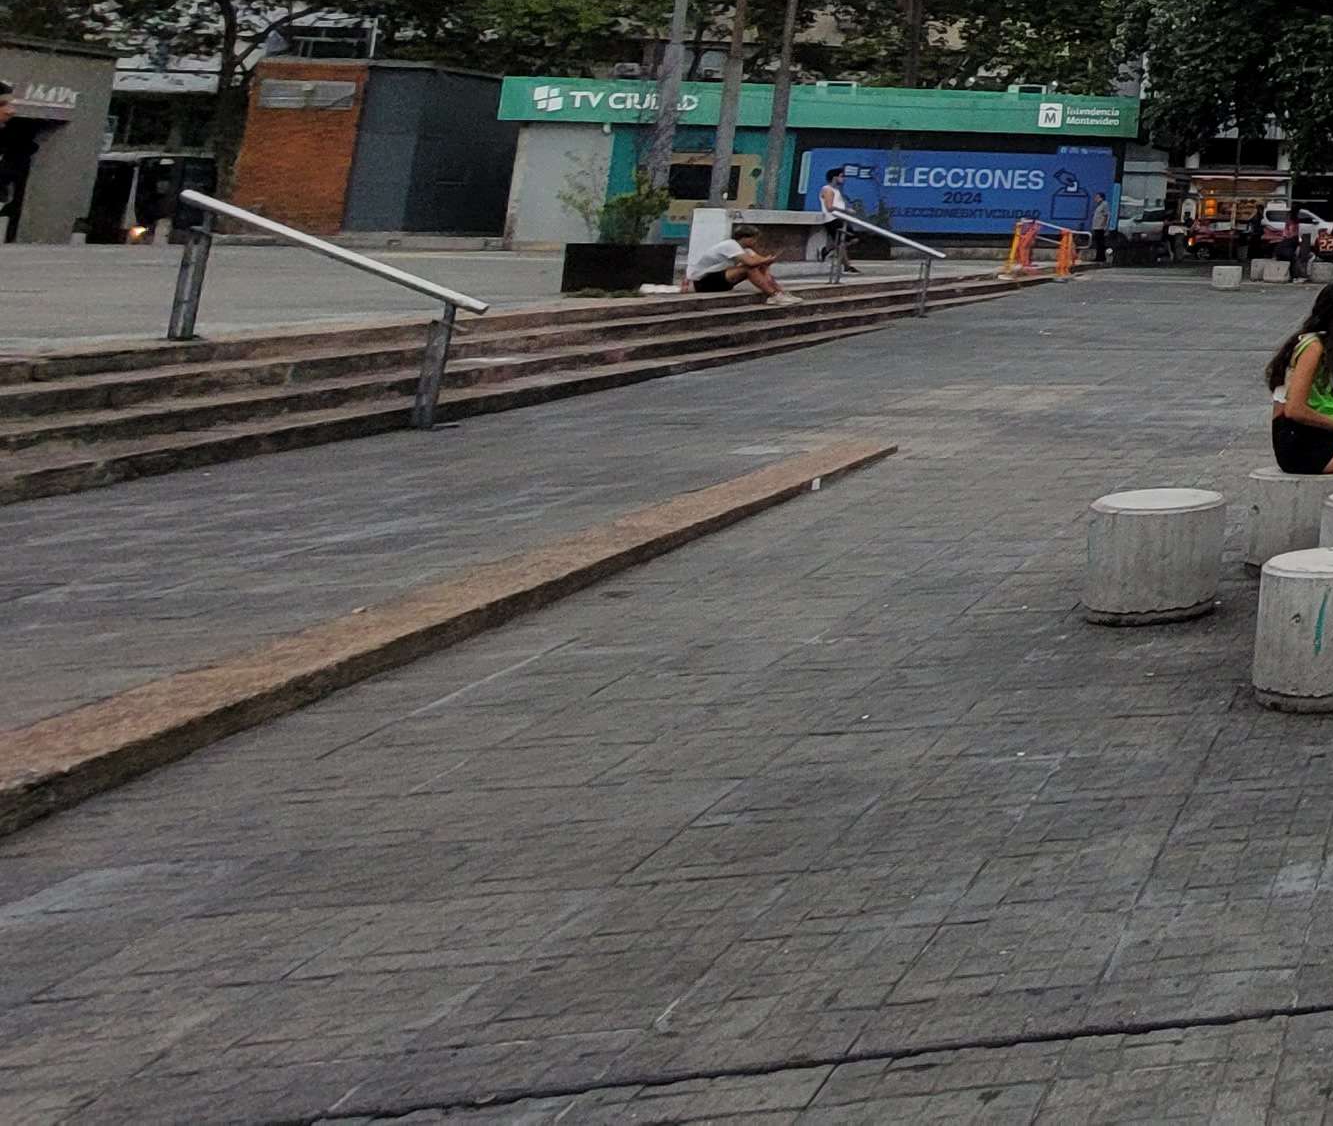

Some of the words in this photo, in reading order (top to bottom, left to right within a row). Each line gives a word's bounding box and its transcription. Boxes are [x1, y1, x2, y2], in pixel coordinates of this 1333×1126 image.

[569, 90, 604, 109] TV
[608, 92, 699, 111] CIUD
[1066, 116, 1119, 126] Montevideo
[883, 167, 1045, 190] ELECCIONES
[943, 192, 983, 204] 2024
